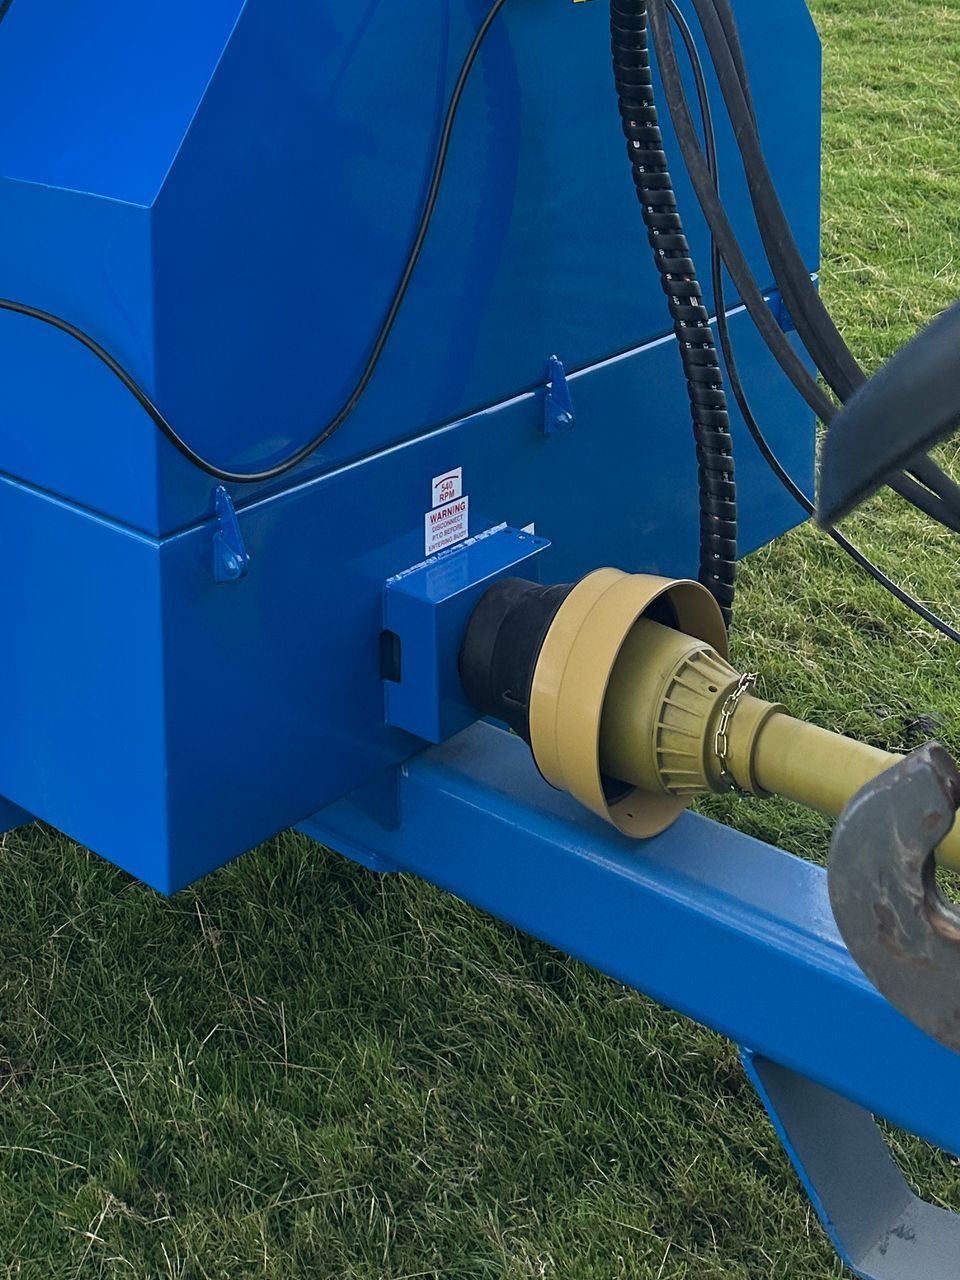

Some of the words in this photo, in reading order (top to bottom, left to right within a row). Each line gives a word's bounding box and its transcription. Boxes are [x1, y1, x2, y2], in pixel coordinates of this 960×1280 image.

[441, 480, 453, 492] 540
[440, 489, 455, 502] RPM
[430, 501, 466, 523] WARNING
[431, 514, 464, 533] DISCONNECT
